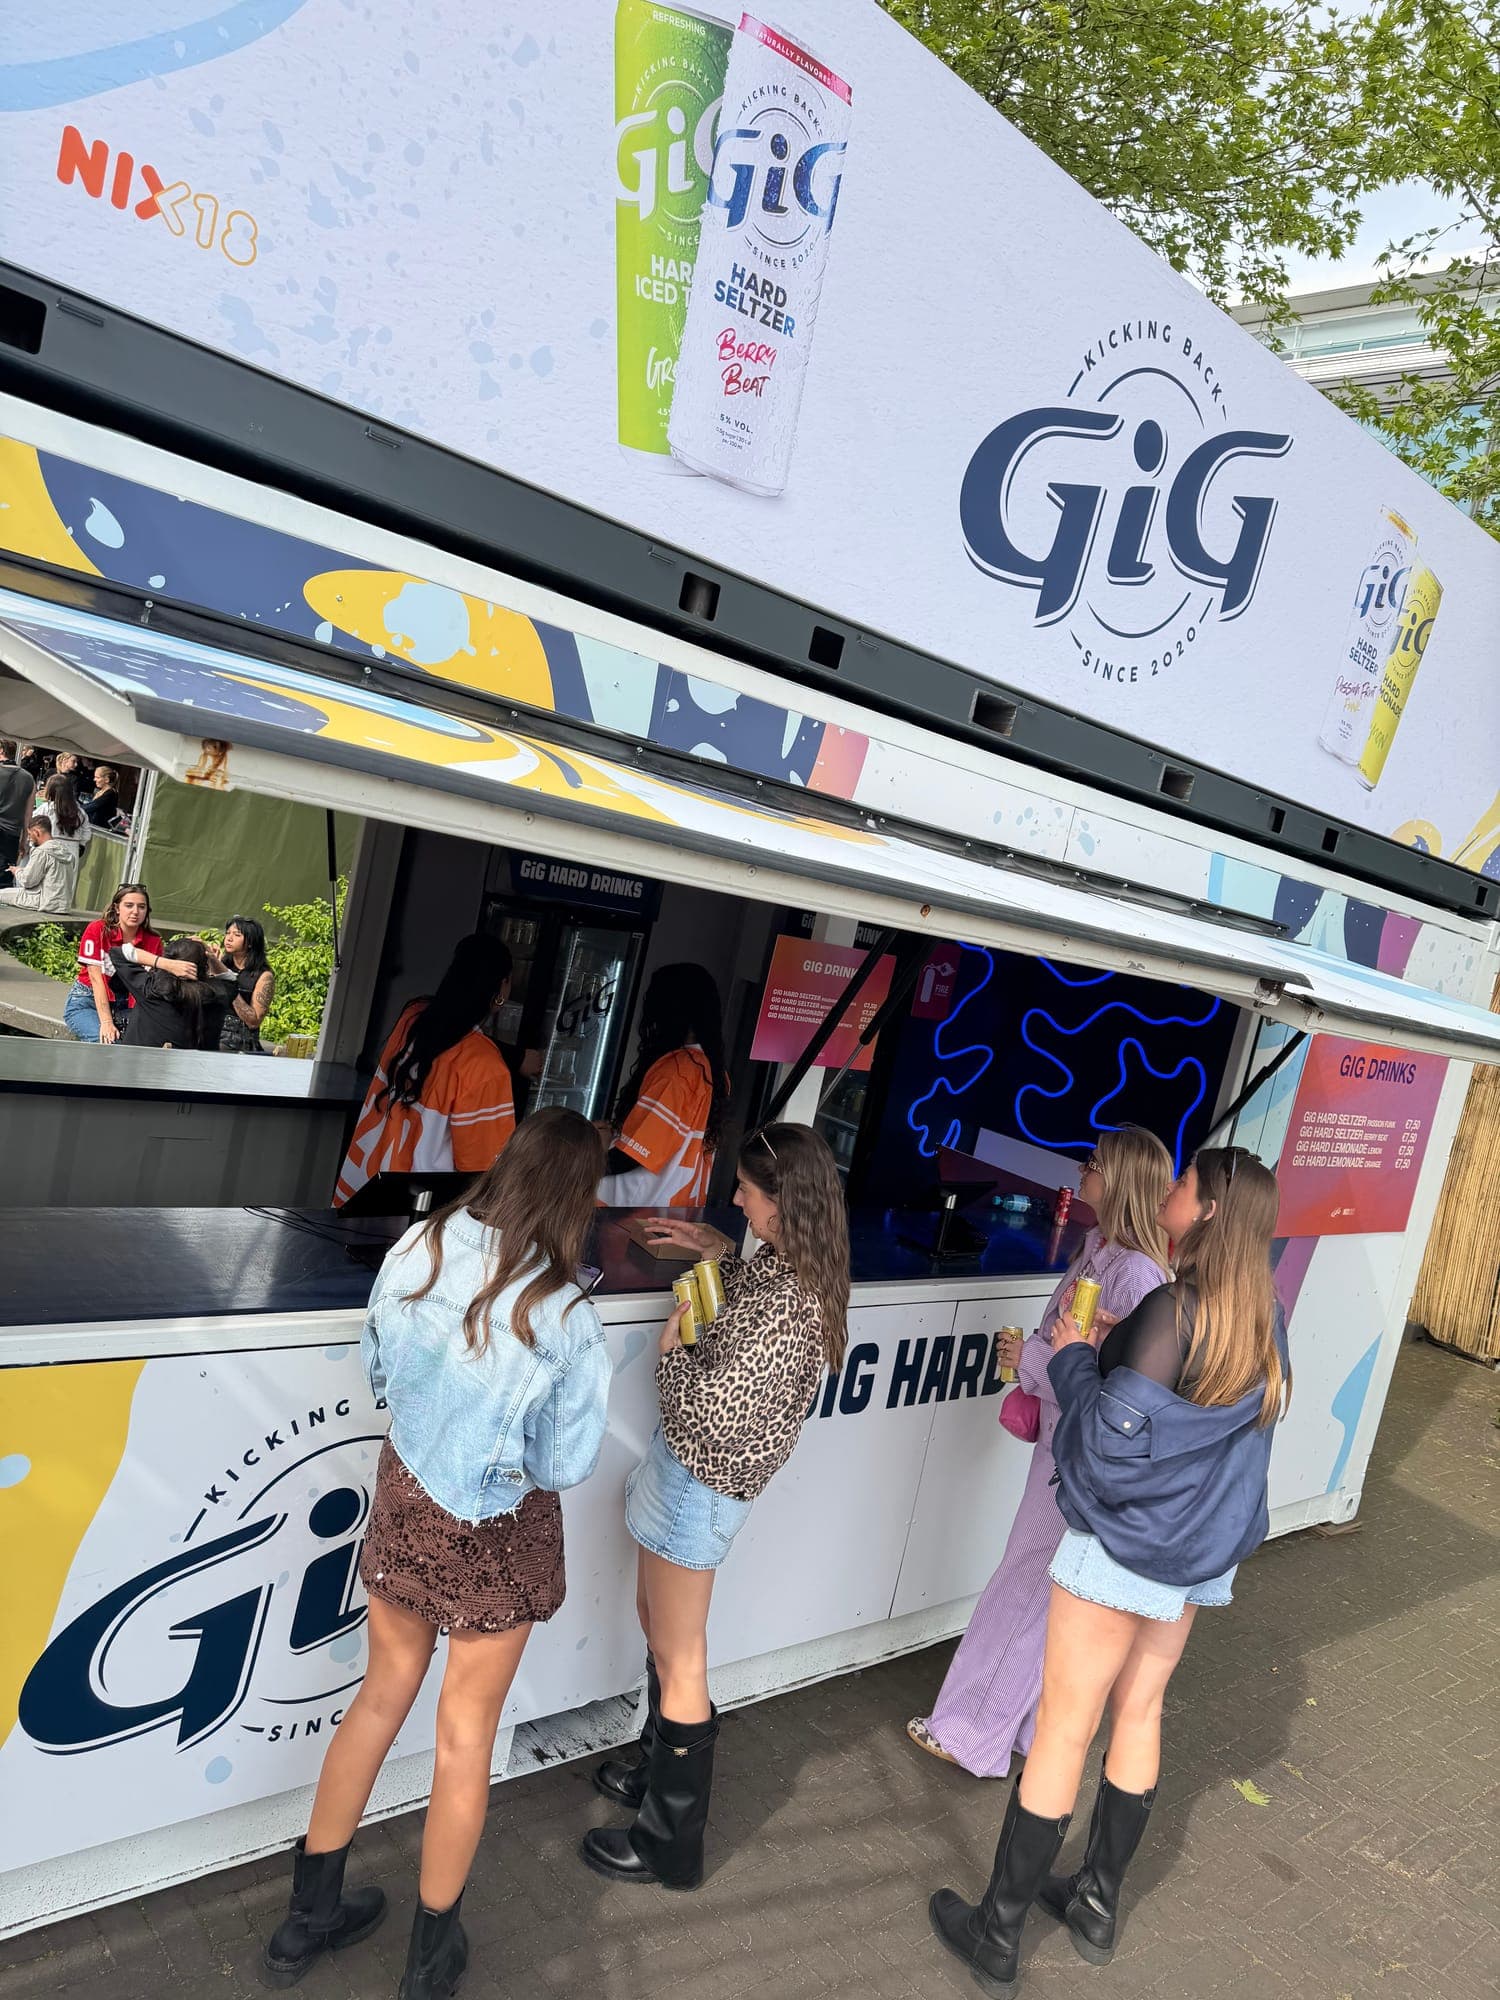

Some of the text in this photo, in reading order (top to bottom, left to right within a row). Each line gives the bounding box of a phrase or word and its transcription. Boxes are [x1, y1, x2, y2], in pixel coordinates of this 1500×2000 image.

[652, 11, 706, 36] REFRESHING
[636, 55, 711, 96] KICKING BACK
[741, 85, 821, 129] KICKING BACK
[707, 128, 848, 241] GiG
[665, 231, 700, 246] SINCE
[752, 246, 786, 268] SINCE
[635, 274, 678, 305] ICED
[730, 261, 788, 309] HARD
[714, 280, 796, 339] SELTZER
[1084, 320, 1223, 403] KICKING BACK
[719, 413, 754, 435] 5% VOL.
[959, 406, 1294, 628] GiG
[1081, 626, 1197, 683] SINCE 2020
[1349, 647, 1379, 676] SELTZER
[1357, 637, 1378, 660] HARD
[1382, 673, 1401, 699] HARD
[520, 859, 644, 899] GiG HARD DRINKS
[803, 959, 823, 974] GIG
[935, 984, 950, 994] FIRE
[1340, 1055, 1417, 1085] GIG DRINKS
[1313, 1127, 1334, 1139] HARD
[1334, 1128, 1364, 1141] SELTZER
[1402, 1132, 1418, 1145] €7,50
[1317, 1112, 1338, 1125] HARD
[1338, 1113, 1368, 1126] SELTZER
[1405, 1119, 1421, 1131] €7,50
[1305, 1156, 1328, 1168] HARD
[1327, 1156, 1365, 1169] LEMONADE
[1394, 1158, 1411, 1171] €7,50
[1309, 1141, 1331, 1153] HARD
[1330, 1141, 1368, 1155] LEMONADE
[1398, 1145, 1414, 1158] €7,50
[803, 1342, 880, 1420] IG
[203, 1399, 351, 1505] KICKING
[18, 1485, 371, 1756] Gi
[267, 1709, 344, 1743] SINC
